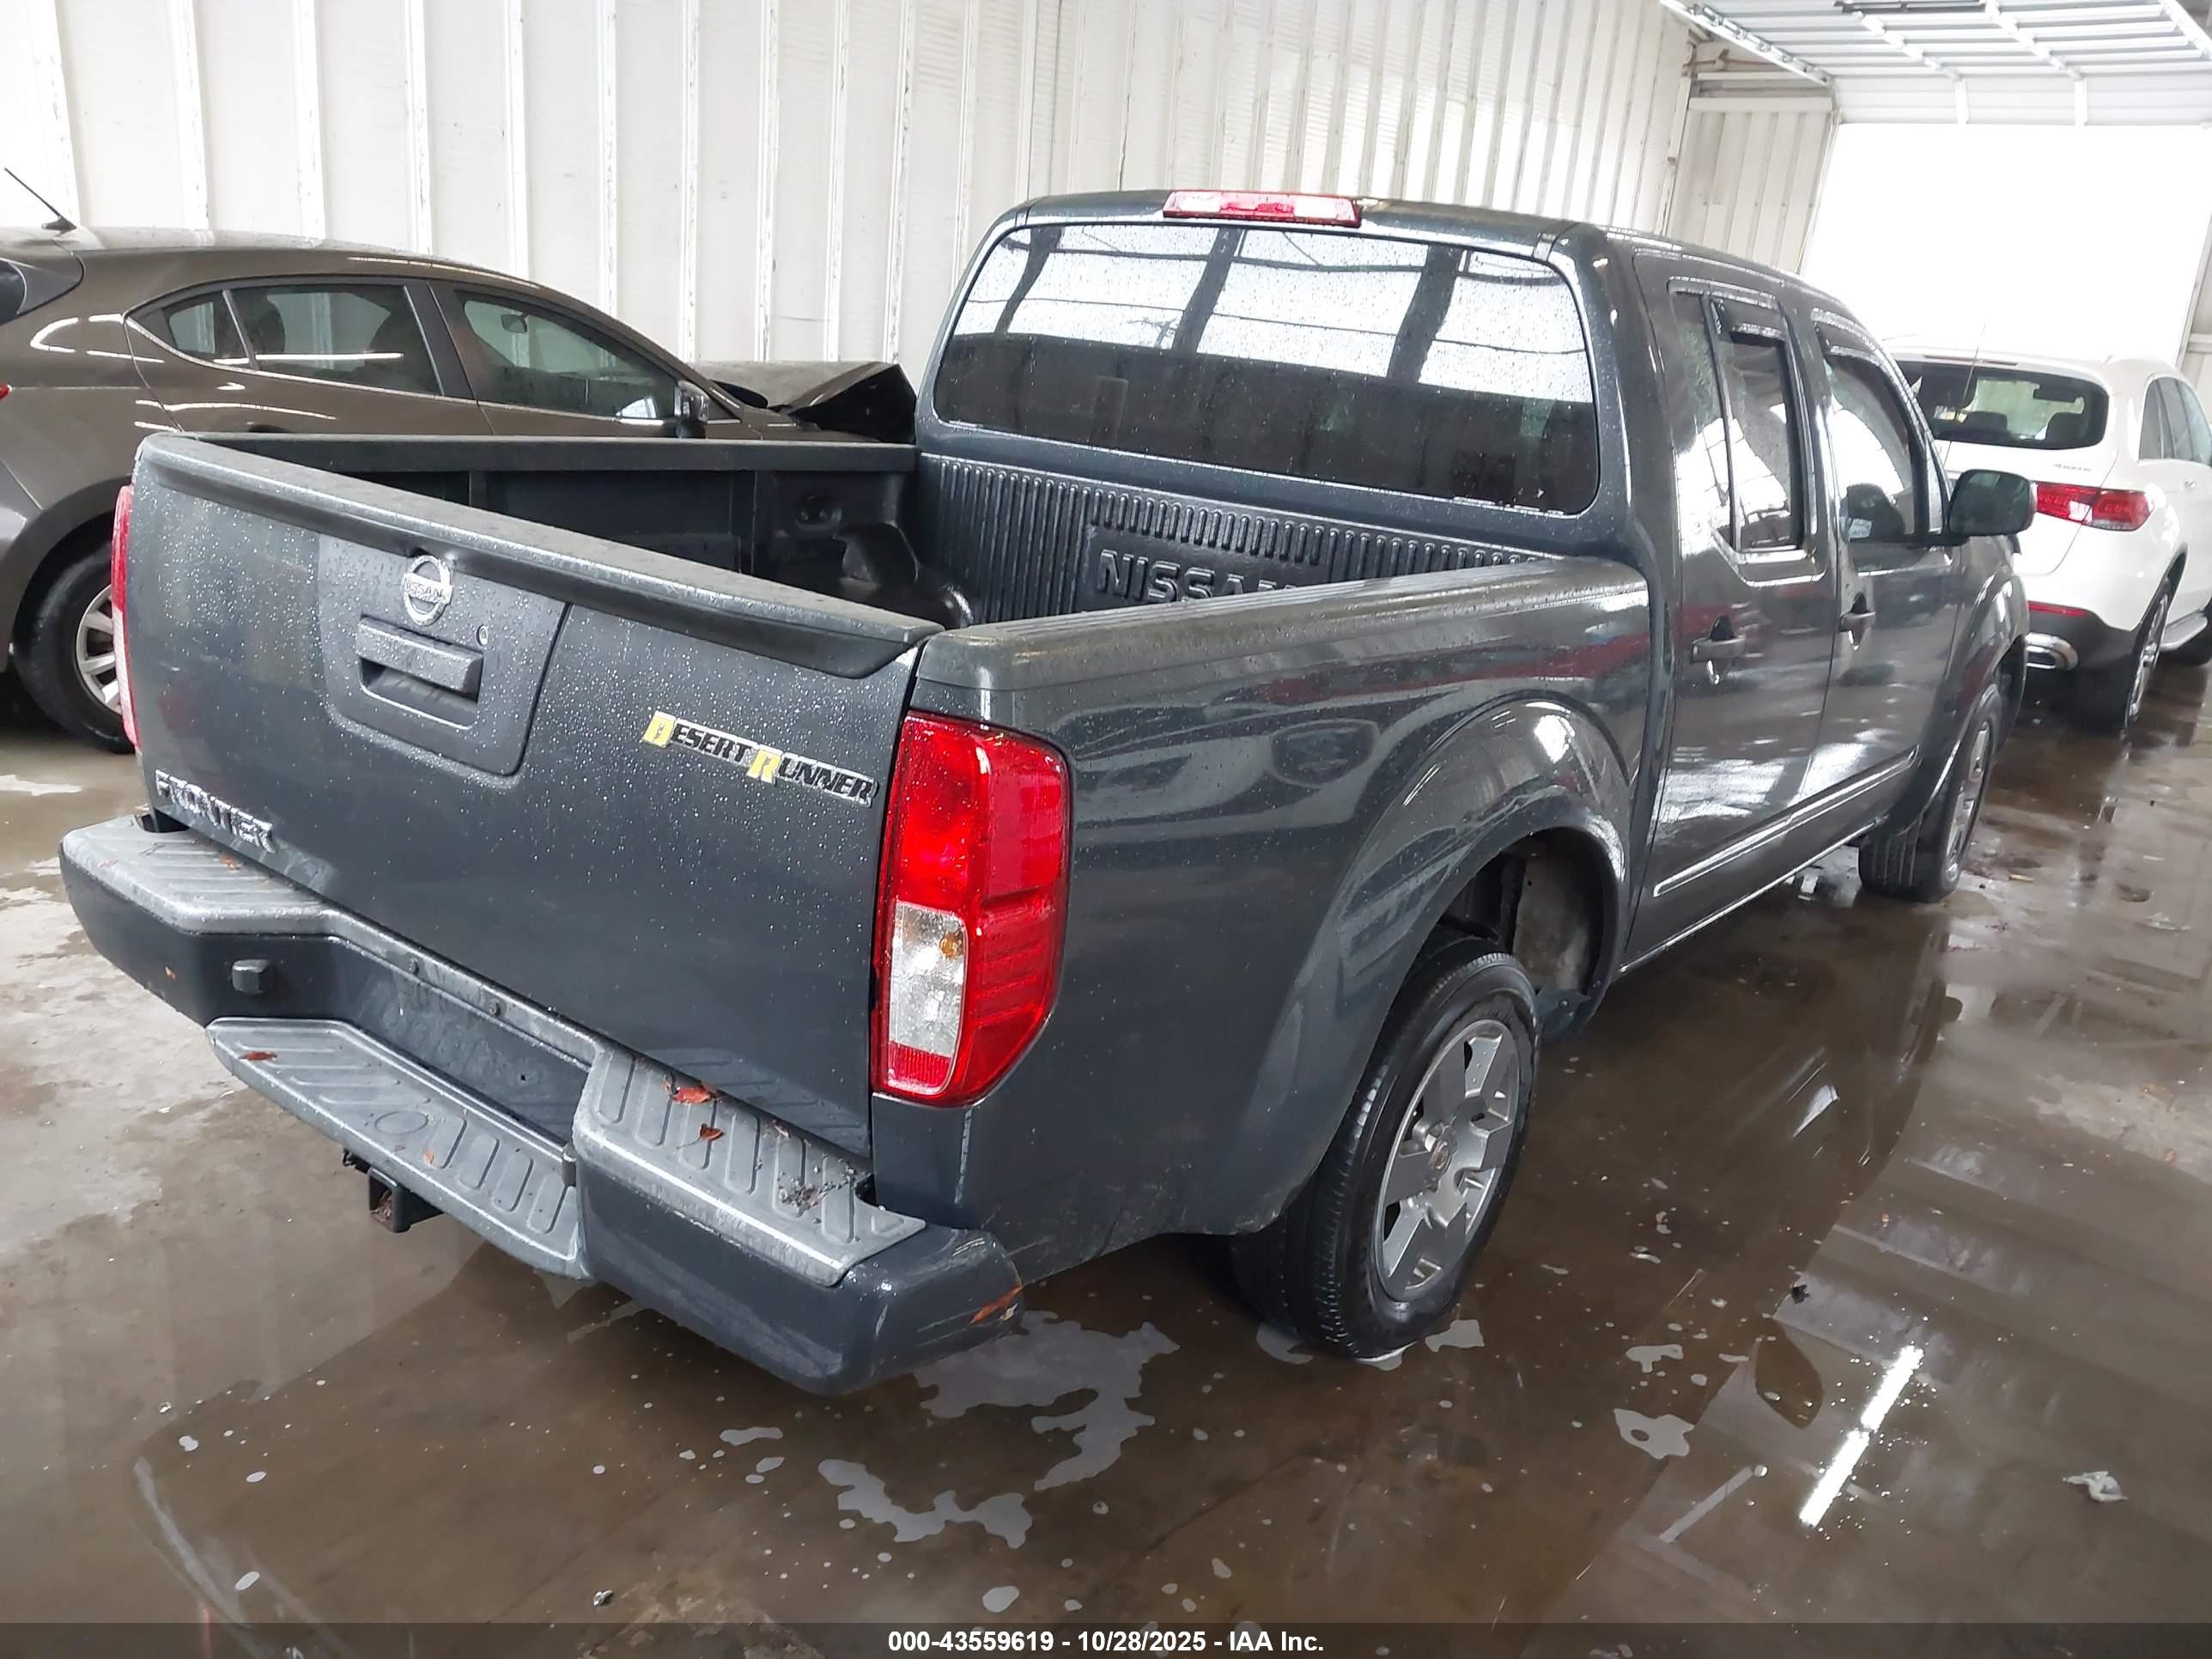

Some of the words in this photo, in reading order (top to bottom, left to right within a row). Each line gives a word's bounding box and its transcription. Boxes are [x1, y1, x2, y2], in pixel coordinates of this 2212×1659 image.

[1096, 550, 1298, 603] NISSA
[642, 710, 754, 763] DESERT
[746, 744, 879, 808] RUNNER
